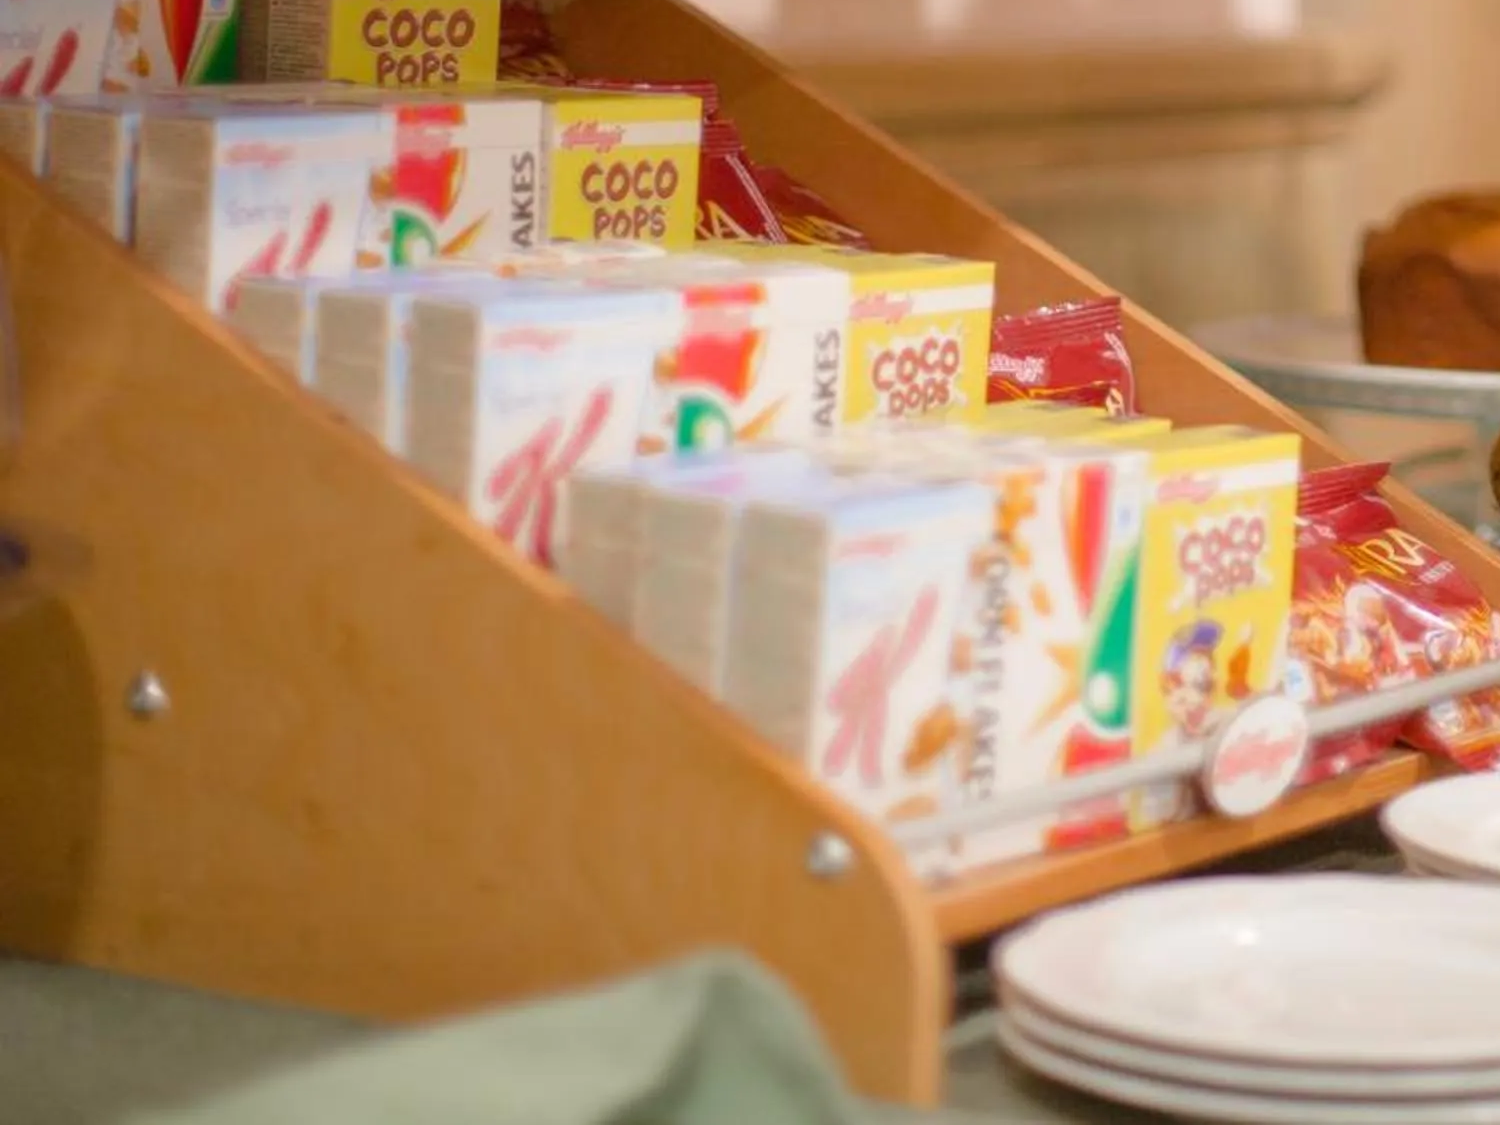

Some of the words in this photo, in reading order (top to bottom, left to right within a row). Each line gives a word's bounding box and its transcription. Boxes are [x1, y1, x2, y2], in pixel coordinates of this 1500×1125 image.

[361, 8, 476, 48] COCO
[375, 51, 460, 88] POPS
[580, 159, 680, 204] COCO
[592, 205, 668, 240] POPS
[871, 336, 962, 392] COCO
[1178, 515, 1267, 576] COCO
